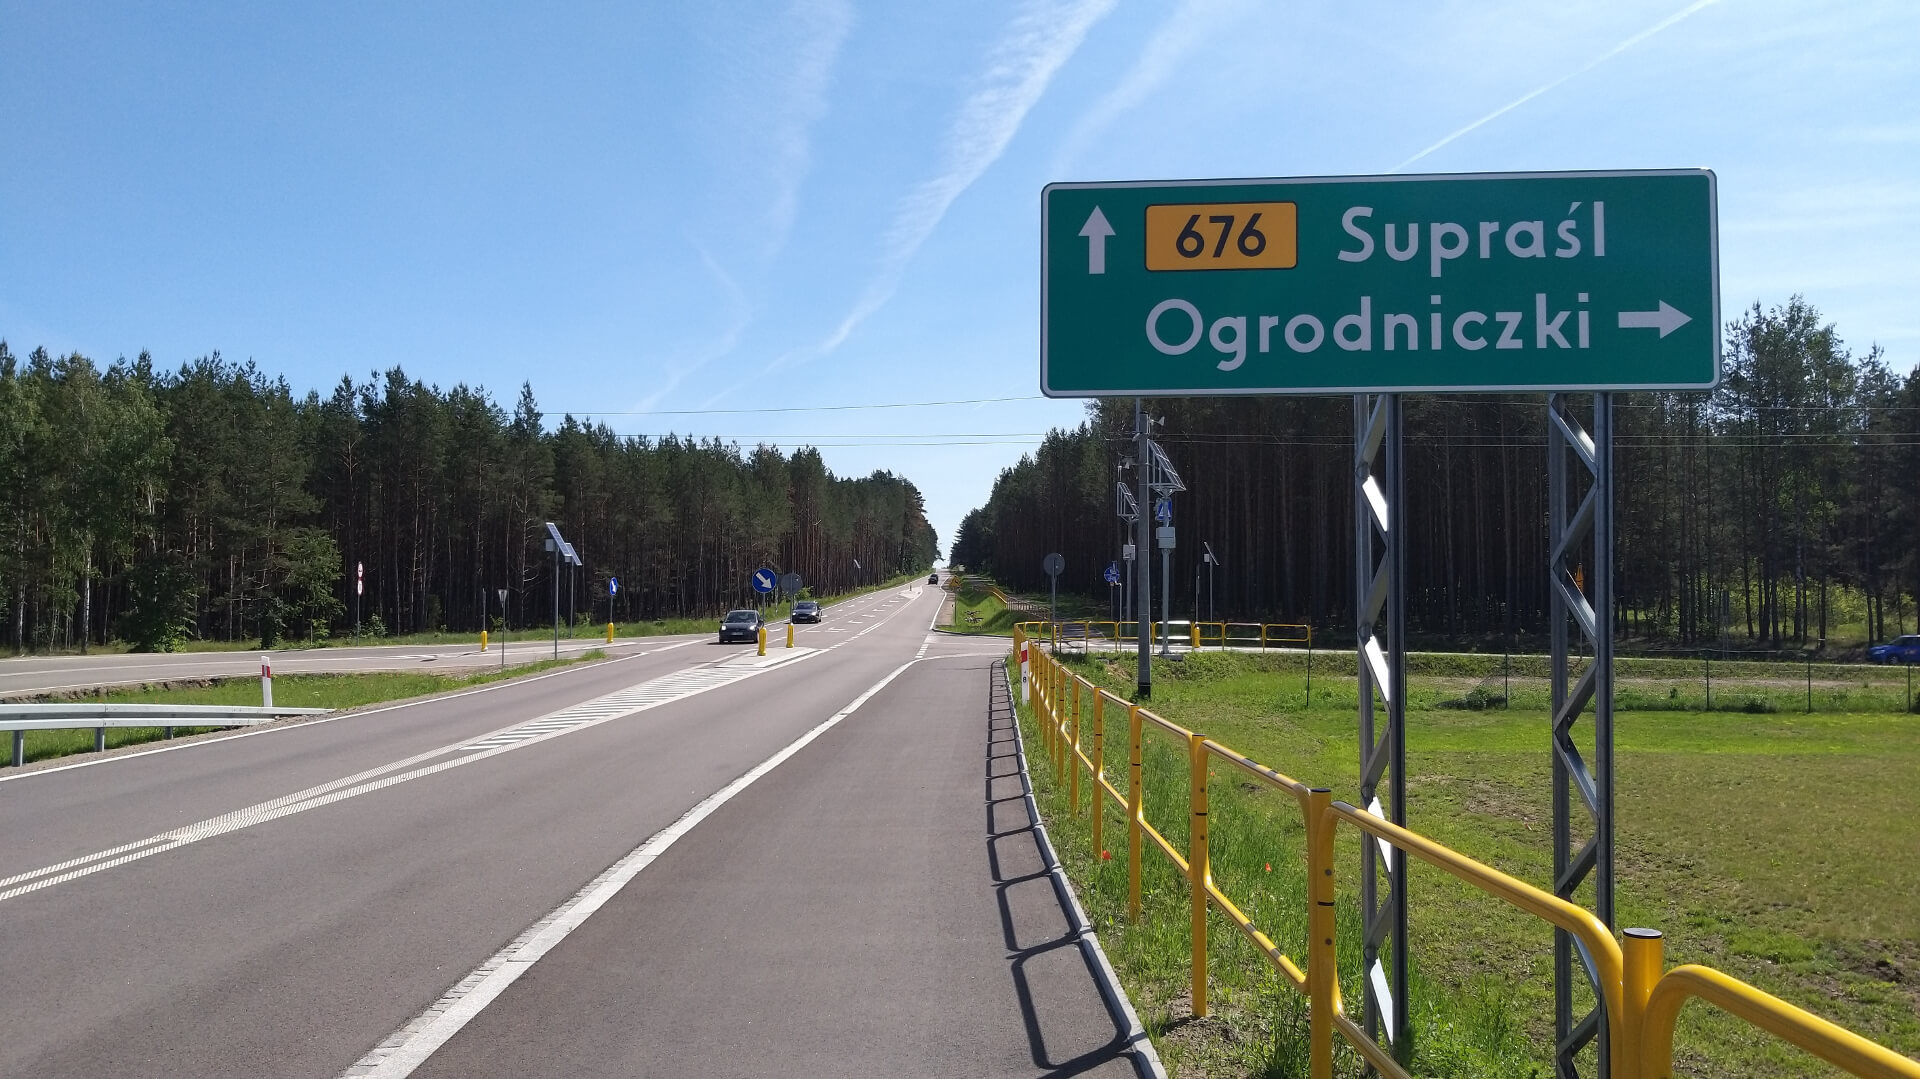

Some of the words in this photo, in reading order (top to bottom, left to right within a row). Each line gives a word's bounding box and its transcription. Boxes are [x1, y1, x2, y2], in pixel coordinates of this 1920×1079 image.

[1176, 213, 1267, 258] 676
[1338, 201, 1605, 277] Supraśl
[1146, 292, 1590, 371] Ogrodniczki
